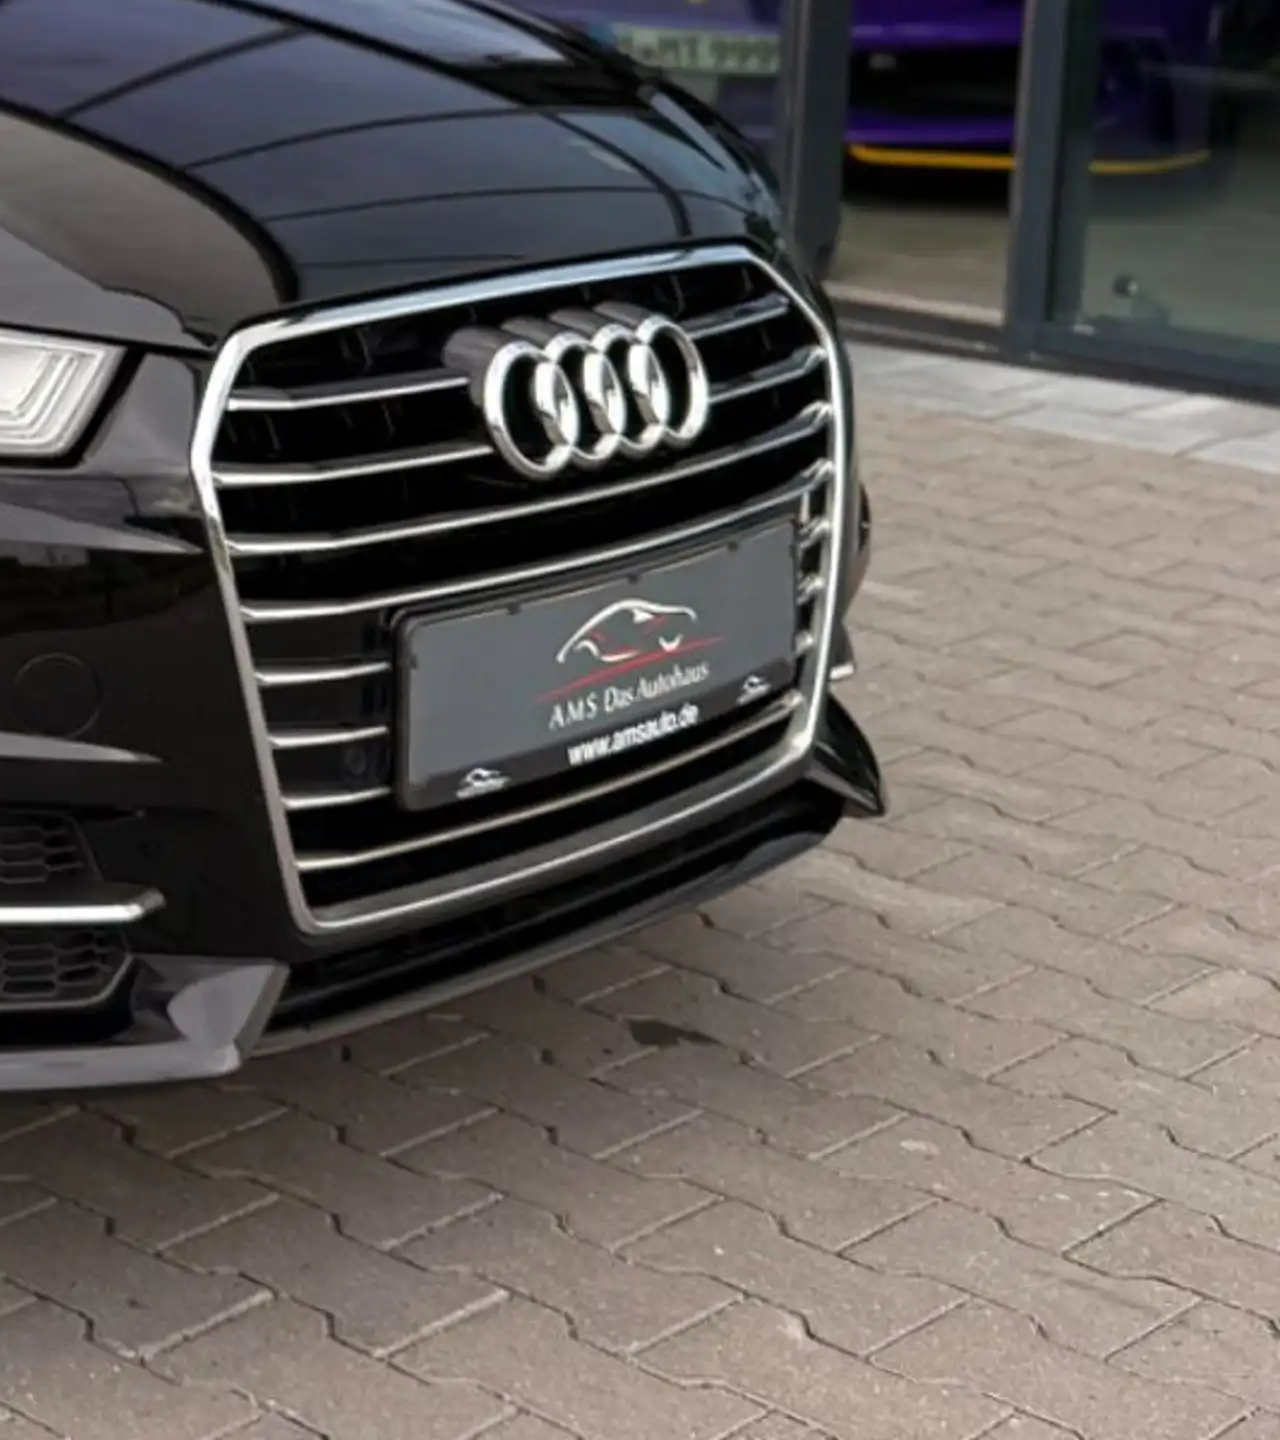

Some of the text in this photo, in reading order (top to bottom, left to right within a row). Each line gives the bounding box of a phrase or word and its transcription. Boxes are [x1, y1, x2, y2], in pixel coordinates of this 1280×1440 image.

[549, 661, 710, 730] AMS Das Autohaus
[567, 701, 700, 766] www.amsauto.de
